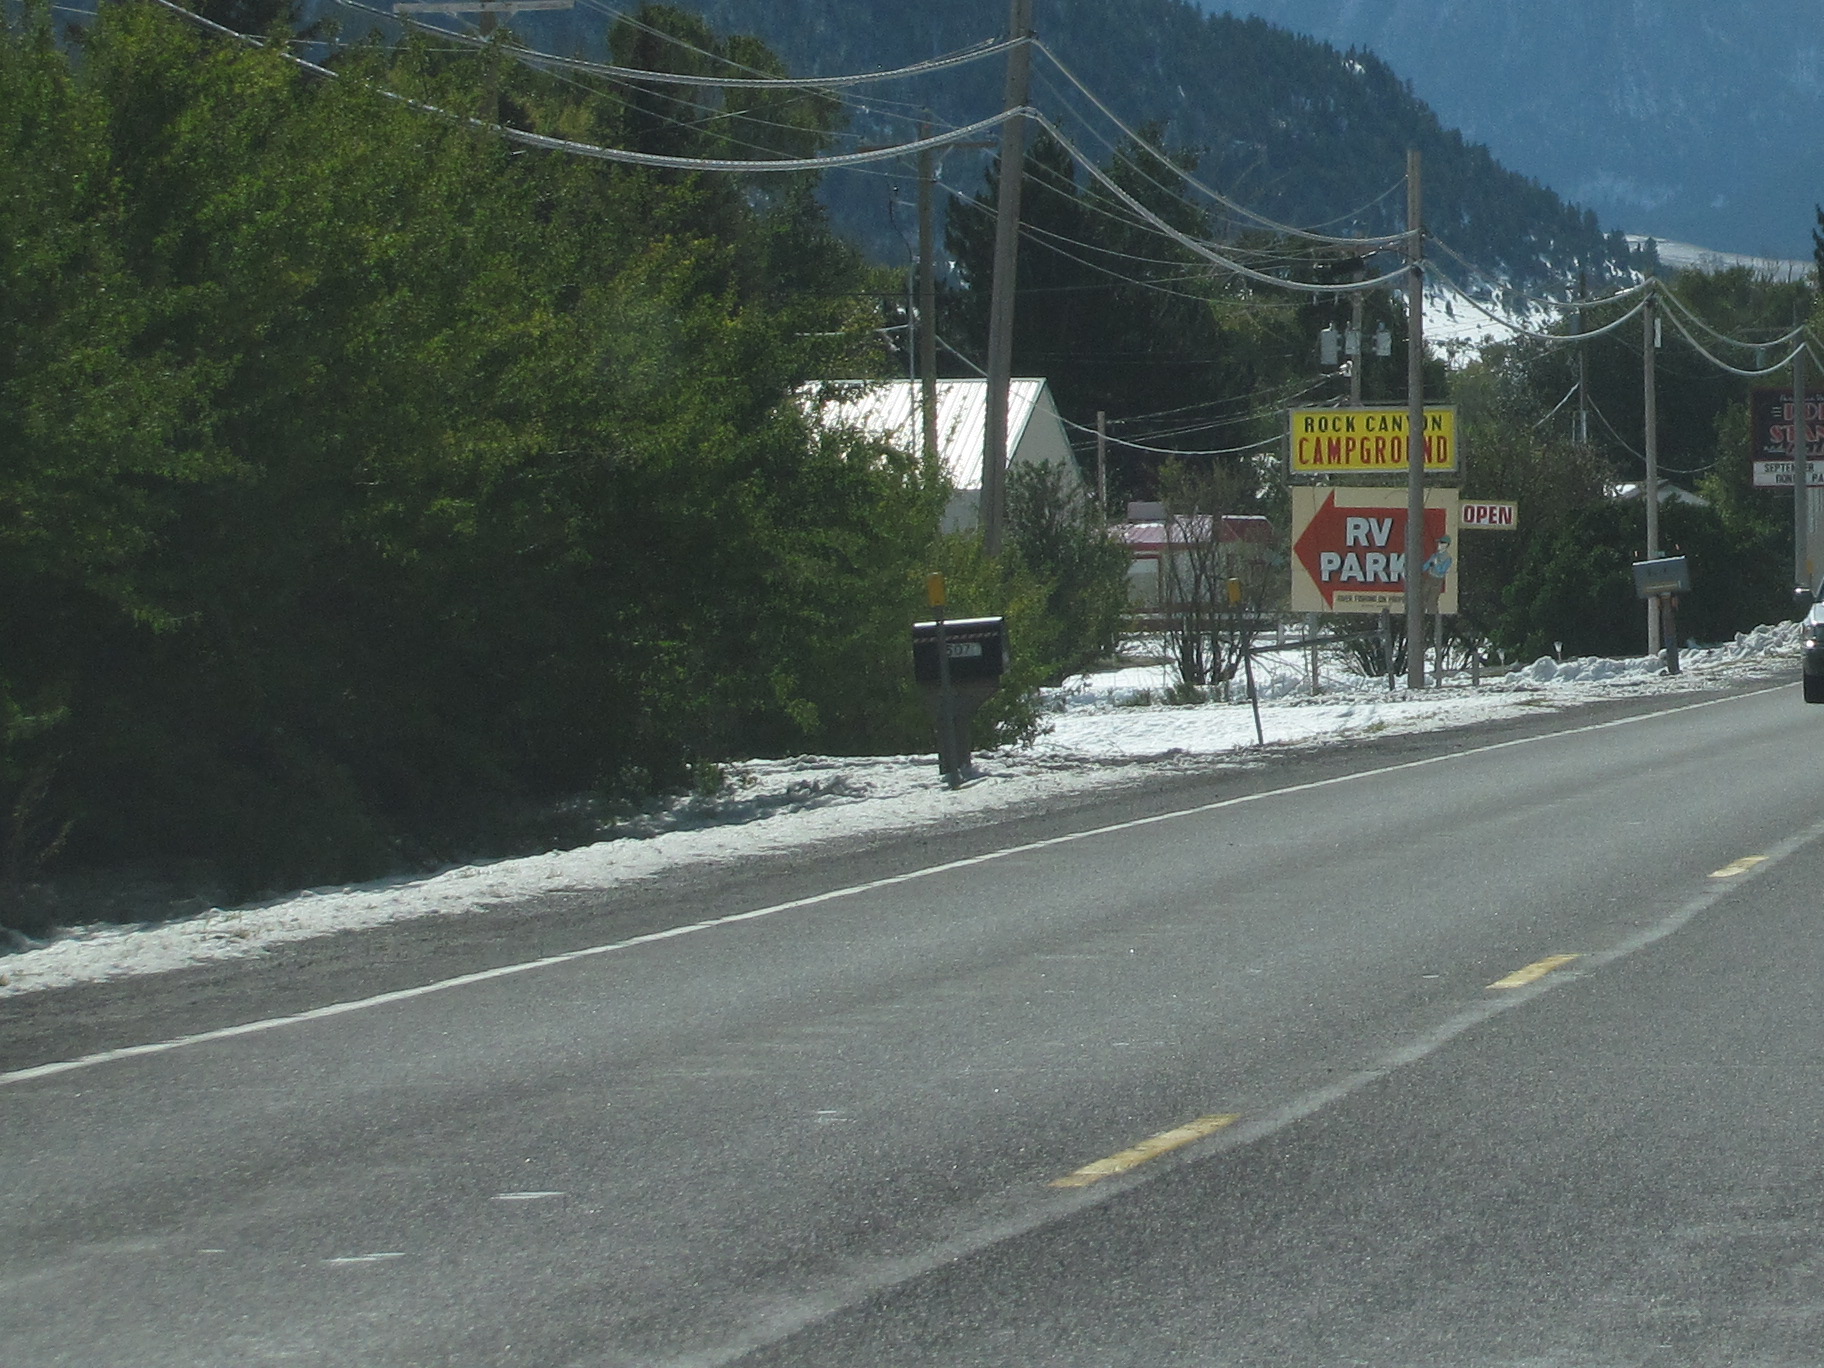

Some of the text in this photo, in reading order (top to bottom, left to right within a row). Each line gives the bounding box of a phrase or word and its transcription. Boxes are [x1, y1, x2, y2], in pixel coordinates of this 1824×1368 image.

[1304, 416, 1356, 433] ROCK
[1764, 462, 1814, 473] SEPTEER
[1463, 504, 1513, 525] OPEN
[1345, 517, 1393, 548] RV
[1319, 551, 1408, 583] PARK
